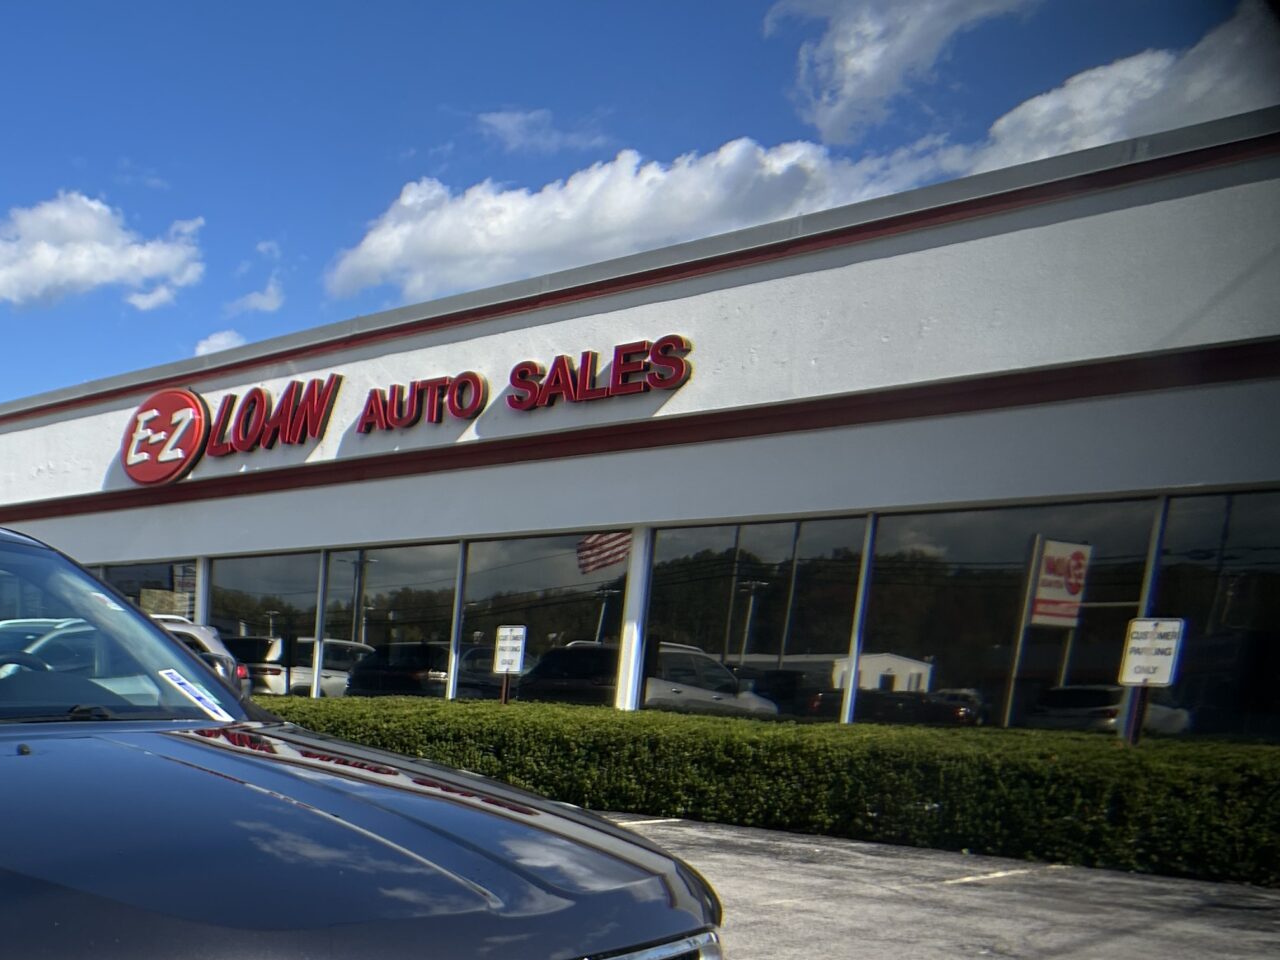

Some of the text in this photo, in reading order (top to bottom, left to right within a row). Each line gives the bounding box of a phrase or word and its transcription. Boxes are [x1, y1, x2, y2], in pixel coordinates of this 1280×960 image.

[127, 334, 693, 467] E-Z LOAN AUTO SALES
